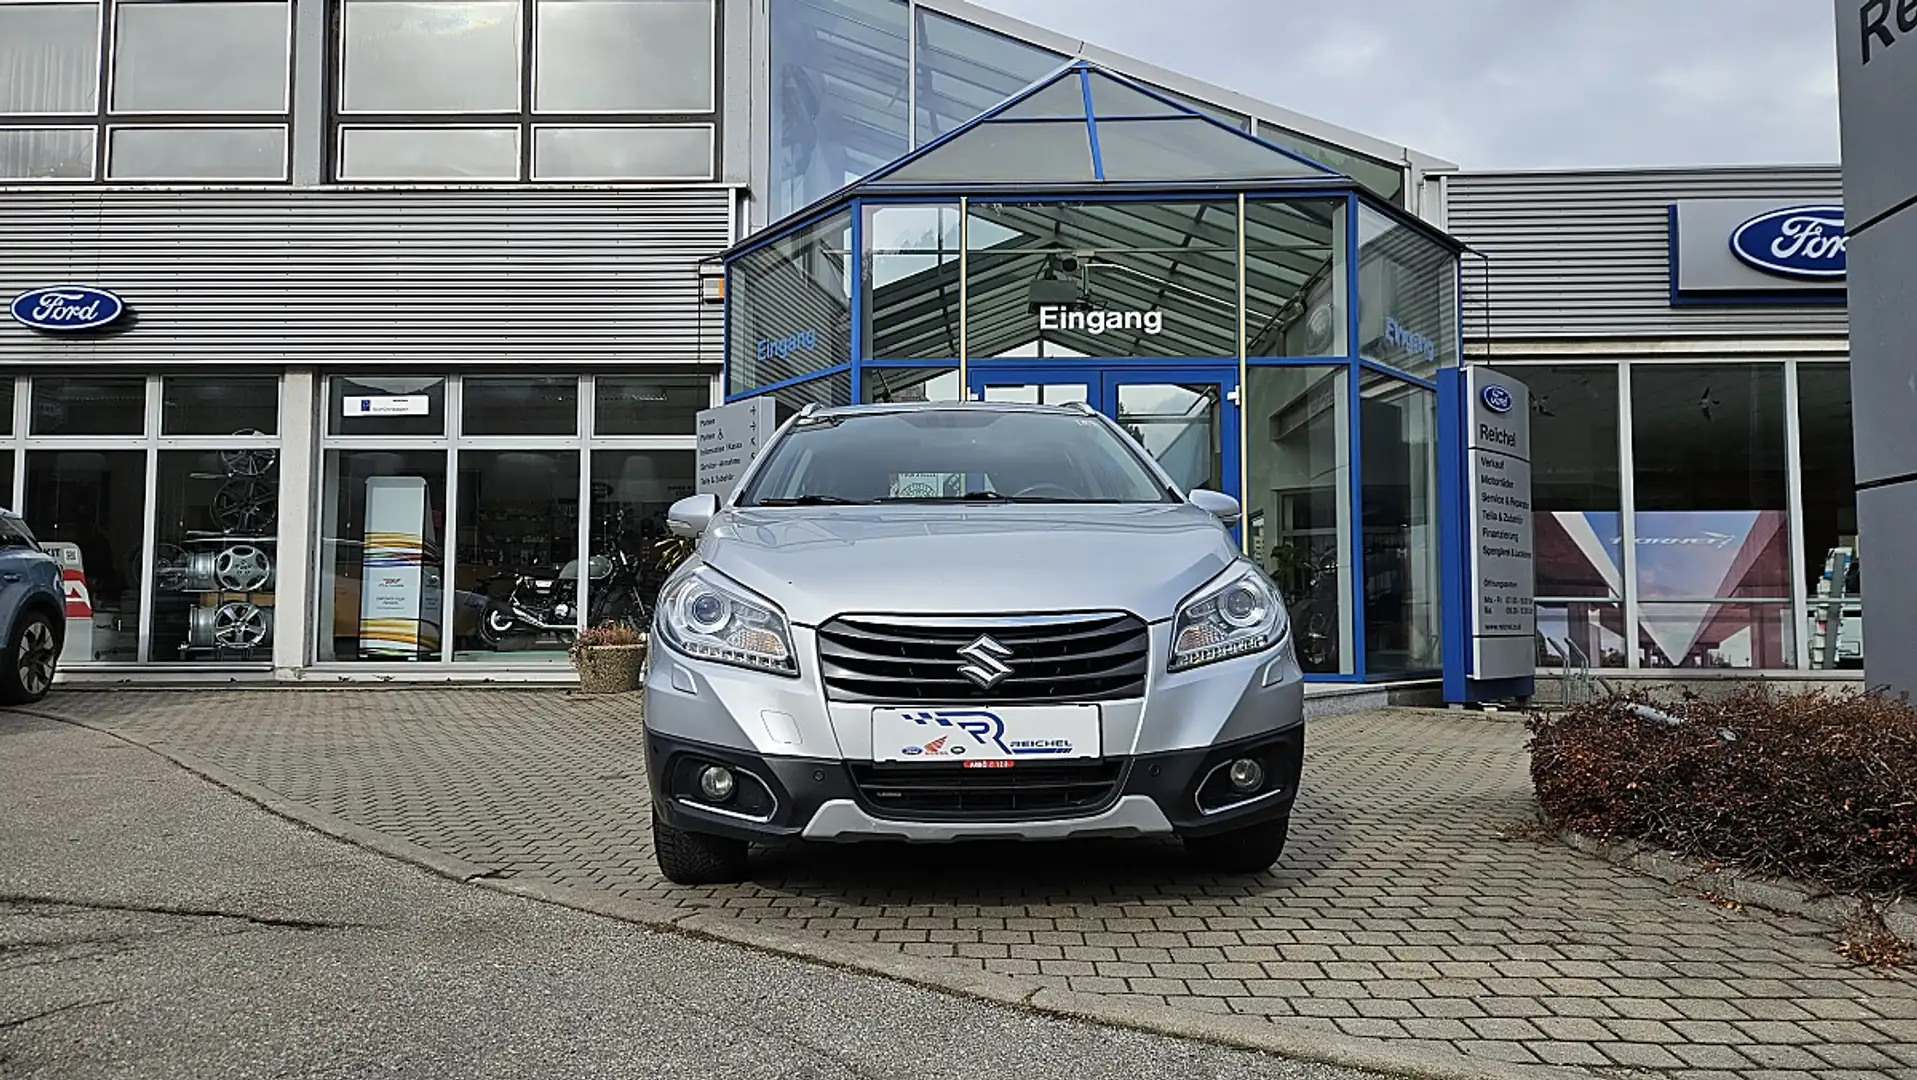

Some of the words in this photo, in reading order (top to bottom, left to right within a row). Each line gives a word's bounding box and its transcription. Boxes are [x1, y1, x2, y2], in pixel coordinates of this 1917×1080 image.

[1771, 216, 1849, 258] For
[32, 293, 101, 321] Ford
[1040, 306, 1163, 335] Eingang
[757, 327, 817, 361] Eingang
[1385, 316, 1435, 362] Eingang
[1479, 423, 1517, 448] Reichel
[1480, 457, 1505, 470] Verkauf
[1481, 492, 1505, 505] Service
[1009, 739, 1073, 748] REICHEL
